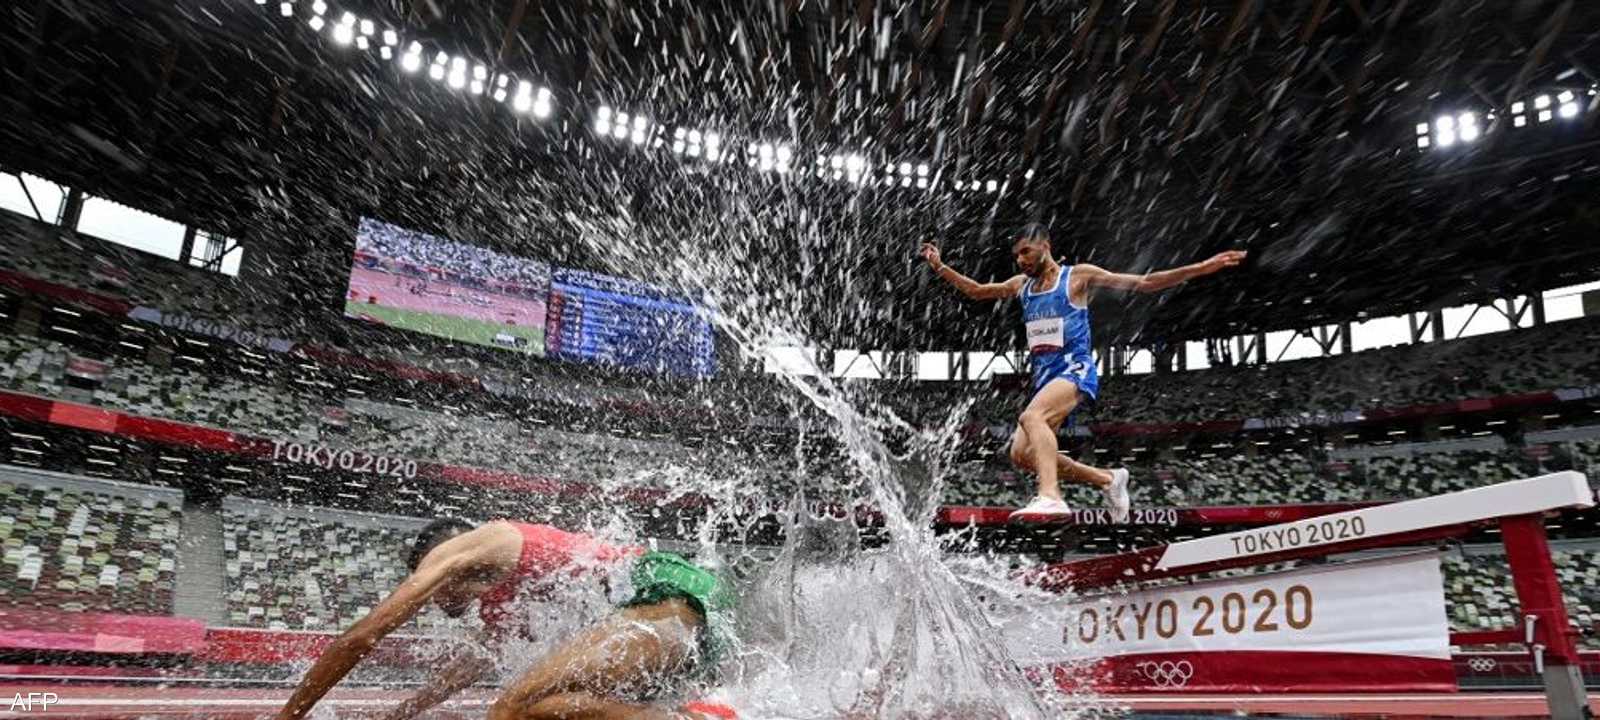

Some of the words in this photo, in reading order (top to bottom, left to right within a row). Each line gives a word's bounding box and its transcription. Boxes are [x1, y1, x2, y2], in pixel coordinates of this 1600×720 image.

[271, 440, 355, 470] TOKYO
[360, 451, 417, 478] 2020
[1134, 508, 1177, 525] 2020
[1230, 527, 1300, 555] TOKYO
[1306, 516, 1365, 544] 2020
[1192, 584, 1312, 638] 2020
